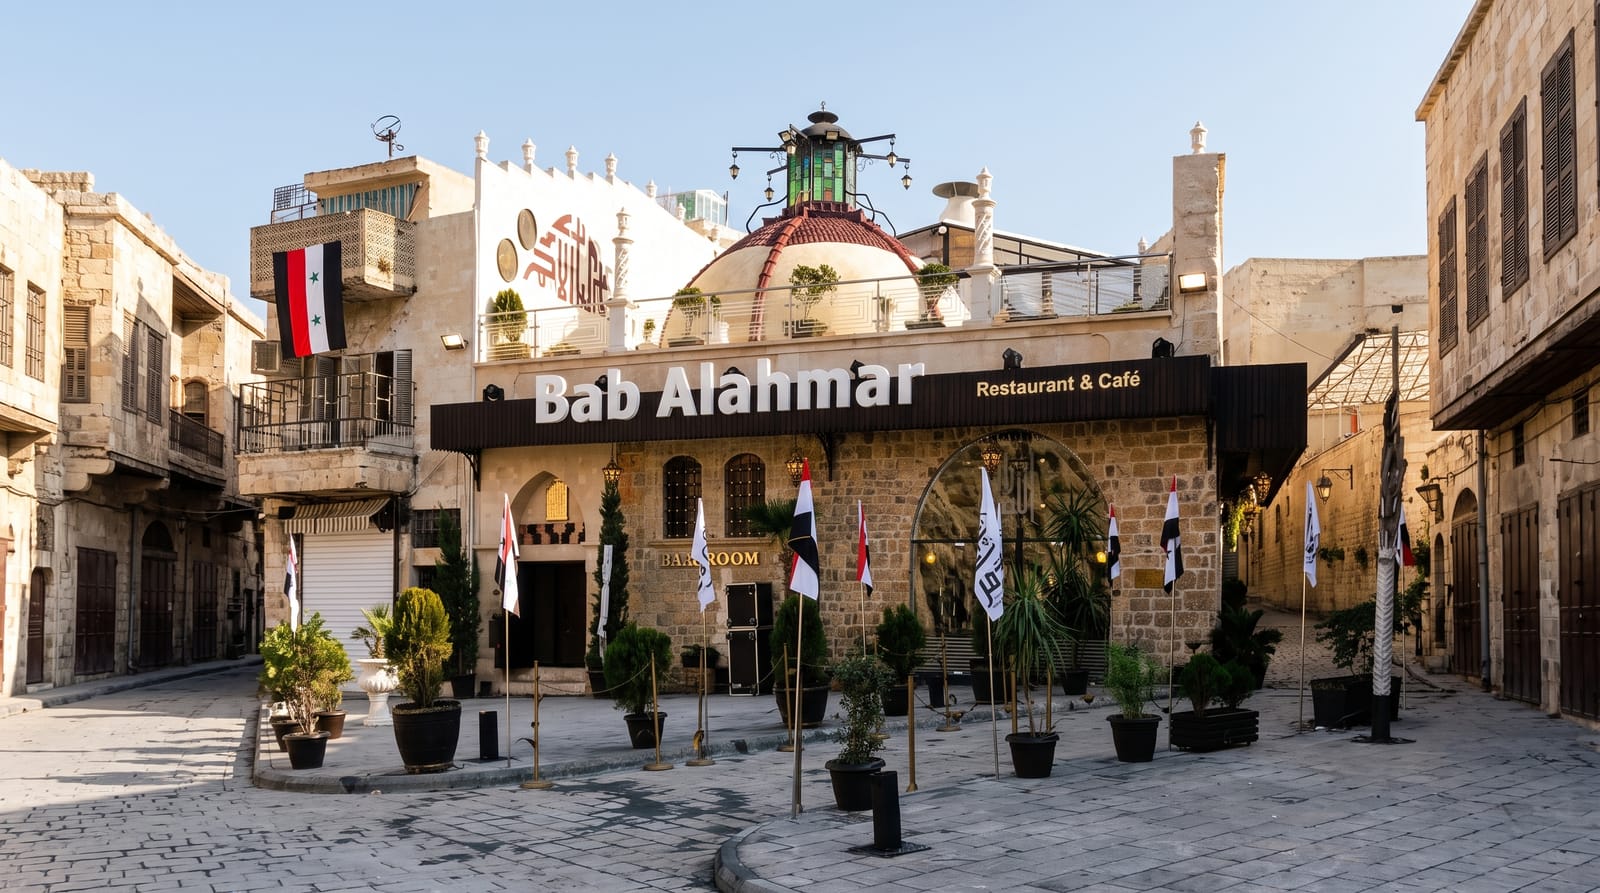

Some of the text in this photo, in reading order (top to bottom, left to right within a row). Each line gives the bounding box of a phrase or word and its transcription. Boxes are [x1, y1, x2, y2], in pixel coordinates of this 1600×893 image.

[535, 358, 925, 424] Bab Alahmar
[976, 369, 1141, 397] Restaurant & Café
